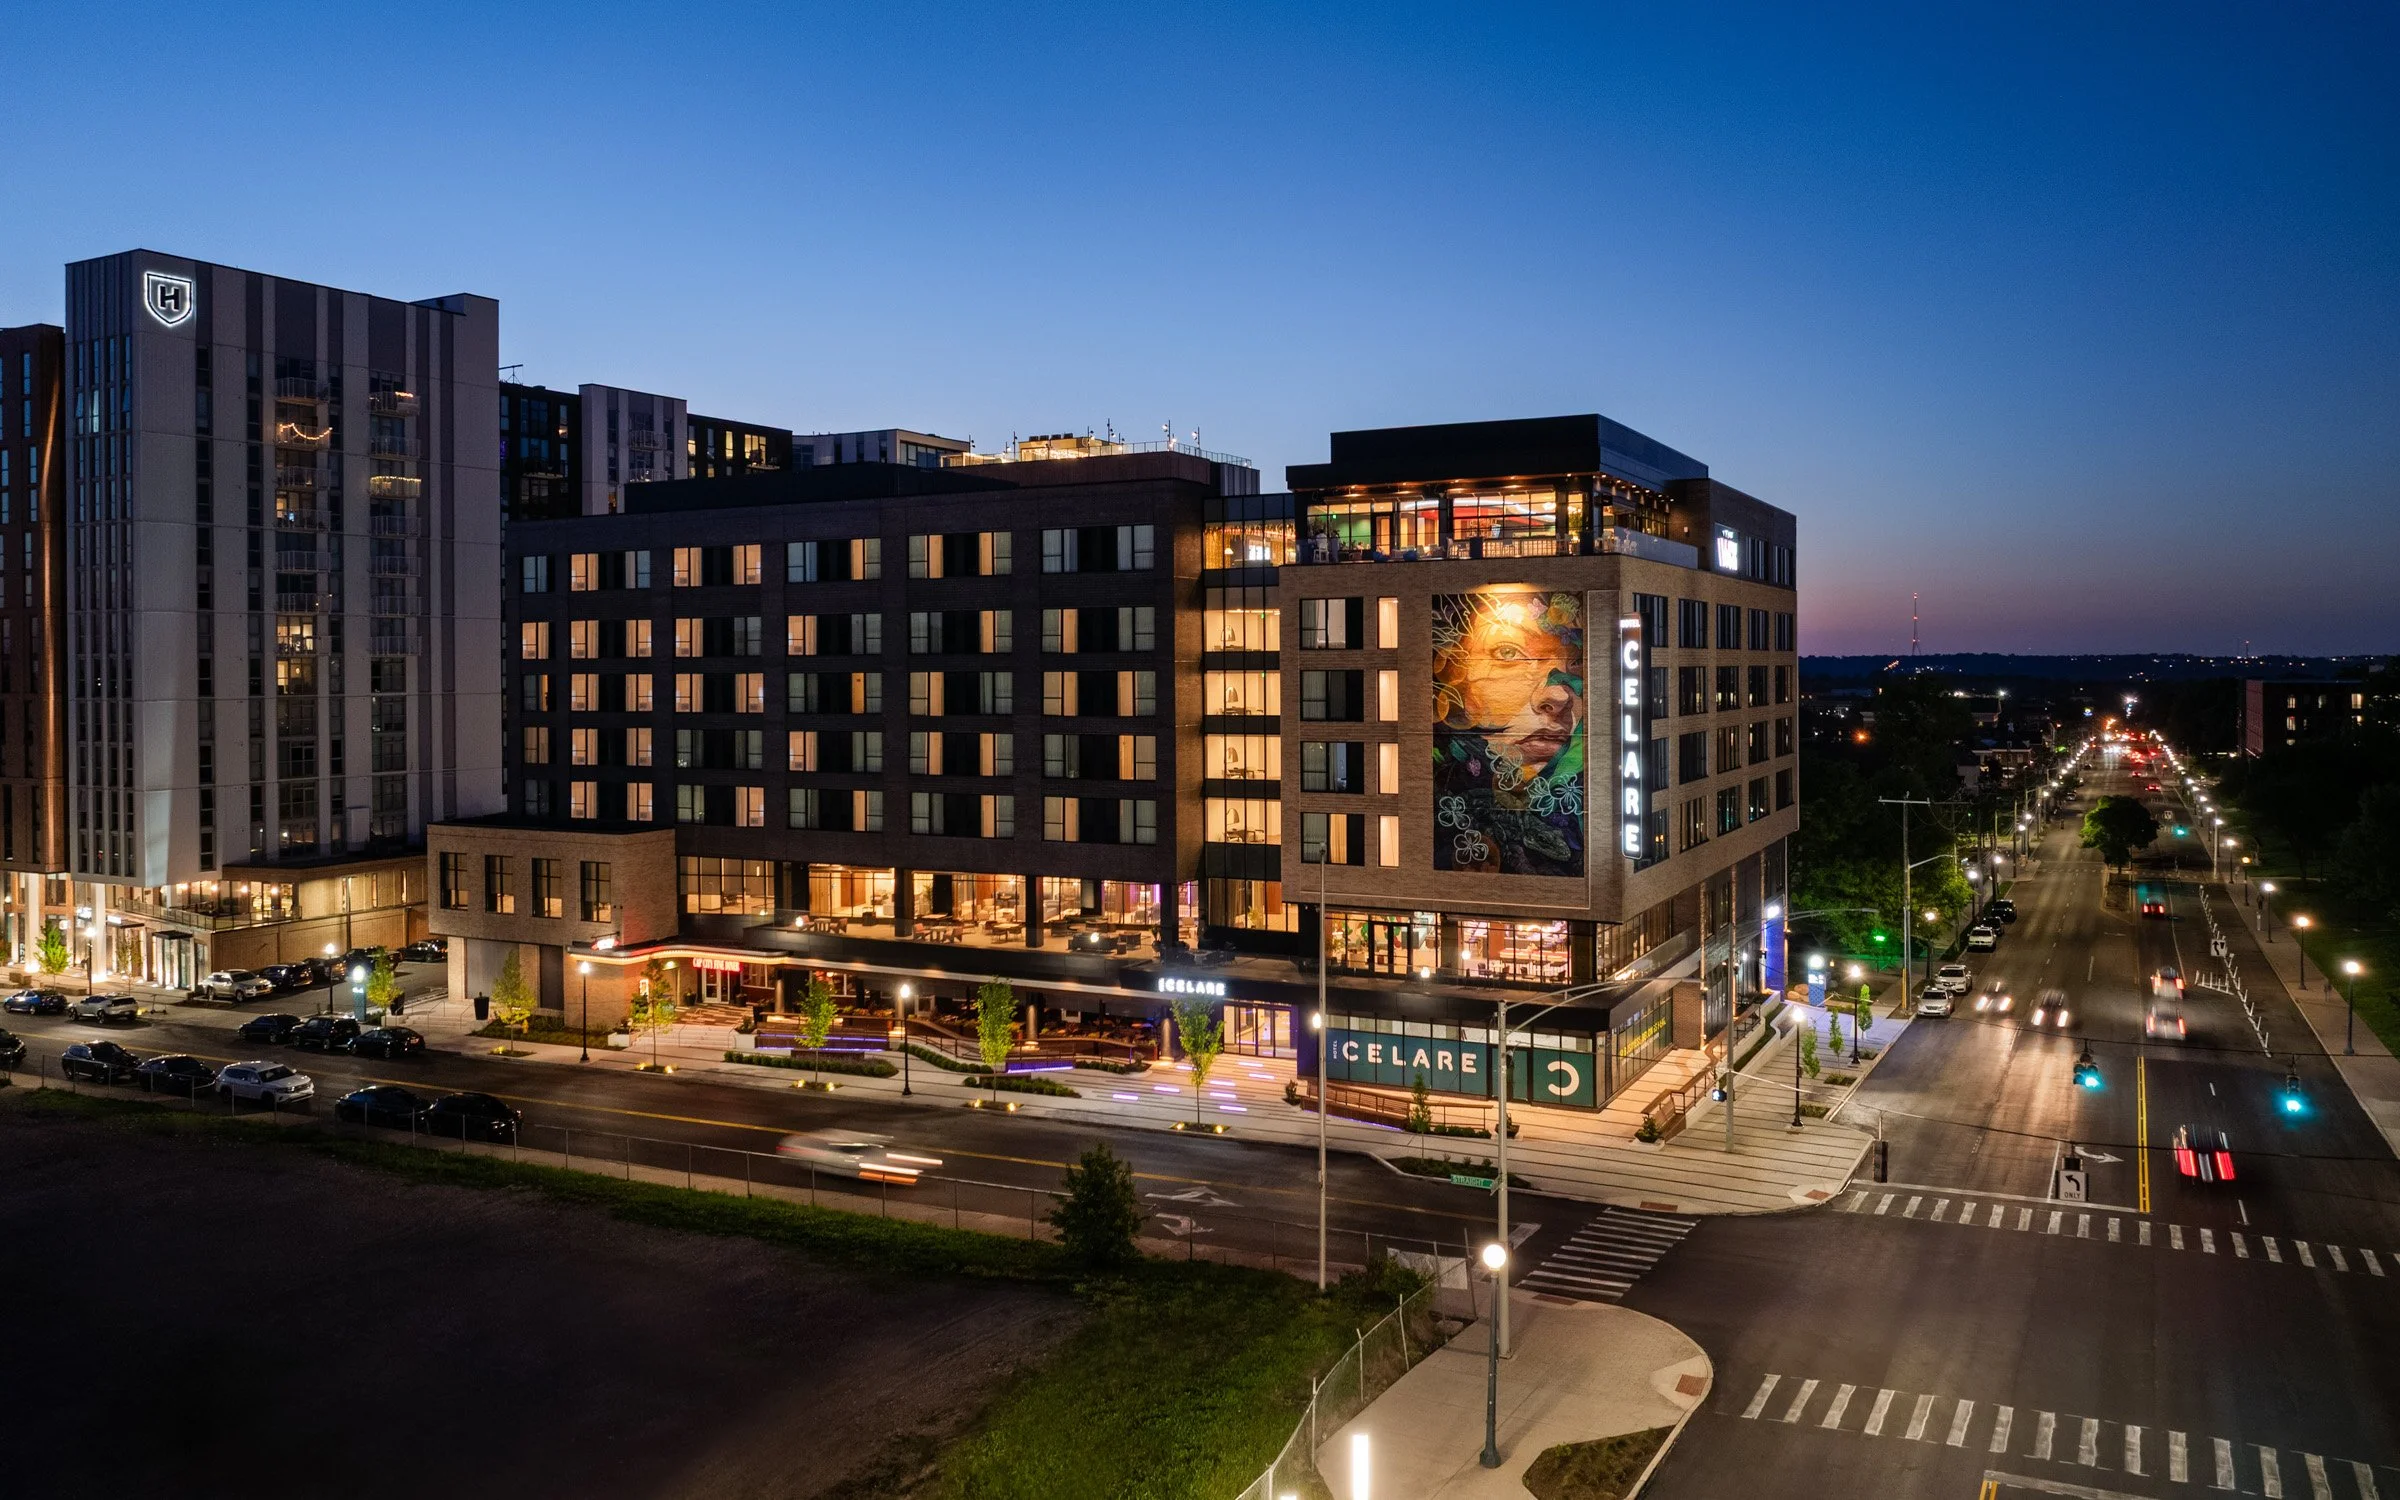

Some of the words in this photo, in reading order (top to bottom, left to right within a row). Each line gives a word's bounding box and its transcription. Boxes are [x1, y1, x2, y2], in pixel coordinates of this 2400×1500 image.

[159, 285, 180, 310] H
[1623, 640, 1640, 853] CELARE
[1165, 978, 1225, 996] CELARE
[1342, 1040, 1477, 1073] CELARE
[1452, 1175, 1483, 1187] STRAIGHT
[2064, 1191, 2081, 1199] ONLY
